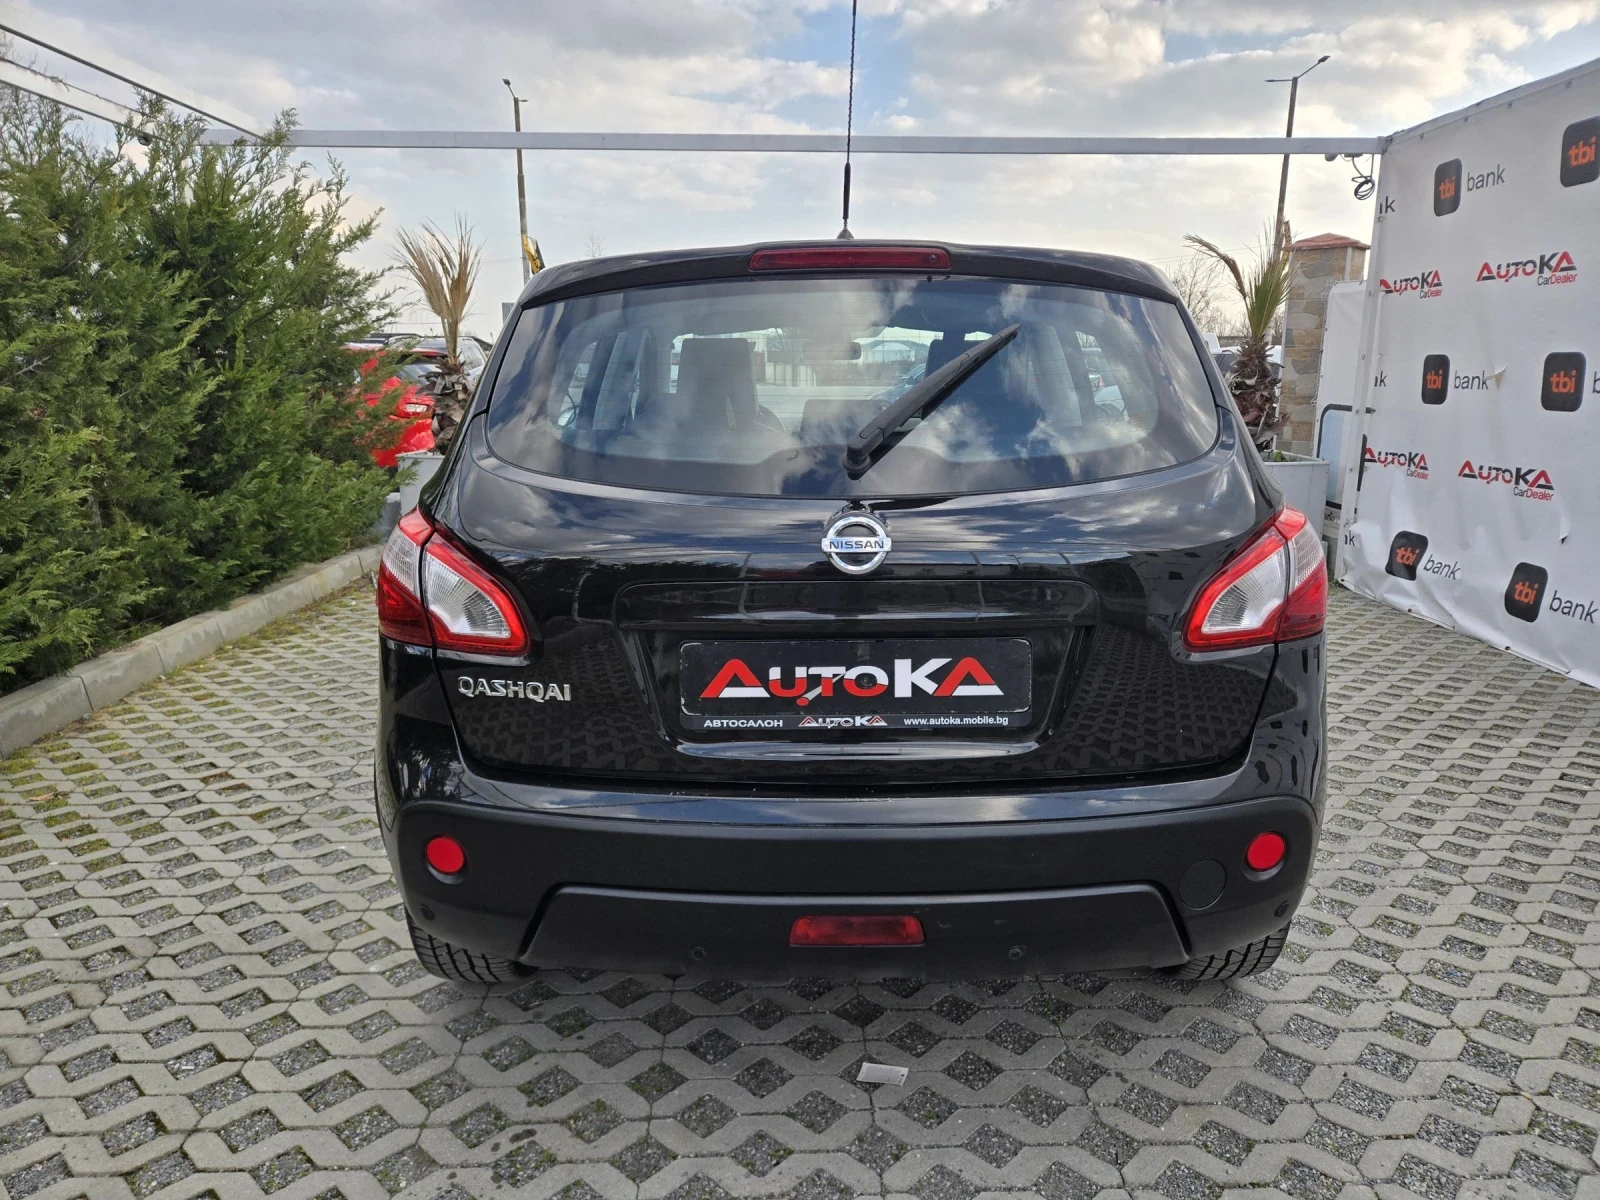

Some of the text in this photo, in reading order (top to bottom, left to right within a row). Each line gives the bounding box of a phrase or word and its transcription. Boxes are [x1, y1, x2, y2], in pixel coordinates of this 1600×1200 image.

[1568, 135, 1597, 166] tbi
[1439, 164, 1506, 199] tbi bank
[1426, 369, 1489, 391] tbi bank
[1550, 369, 1577, 394] tbi
[829, 540, 884, 550] NISSAN
[1396, 547, 1460, 581] tbi bank
[1513, 580, 1599, 624] tbi bank
[457, 676, 572, 703] QASHQAI
[703, 719, 784, 728] АВТОСАЛОН
[903, 715, 1009, 727] www.autoka.mobile.bg
